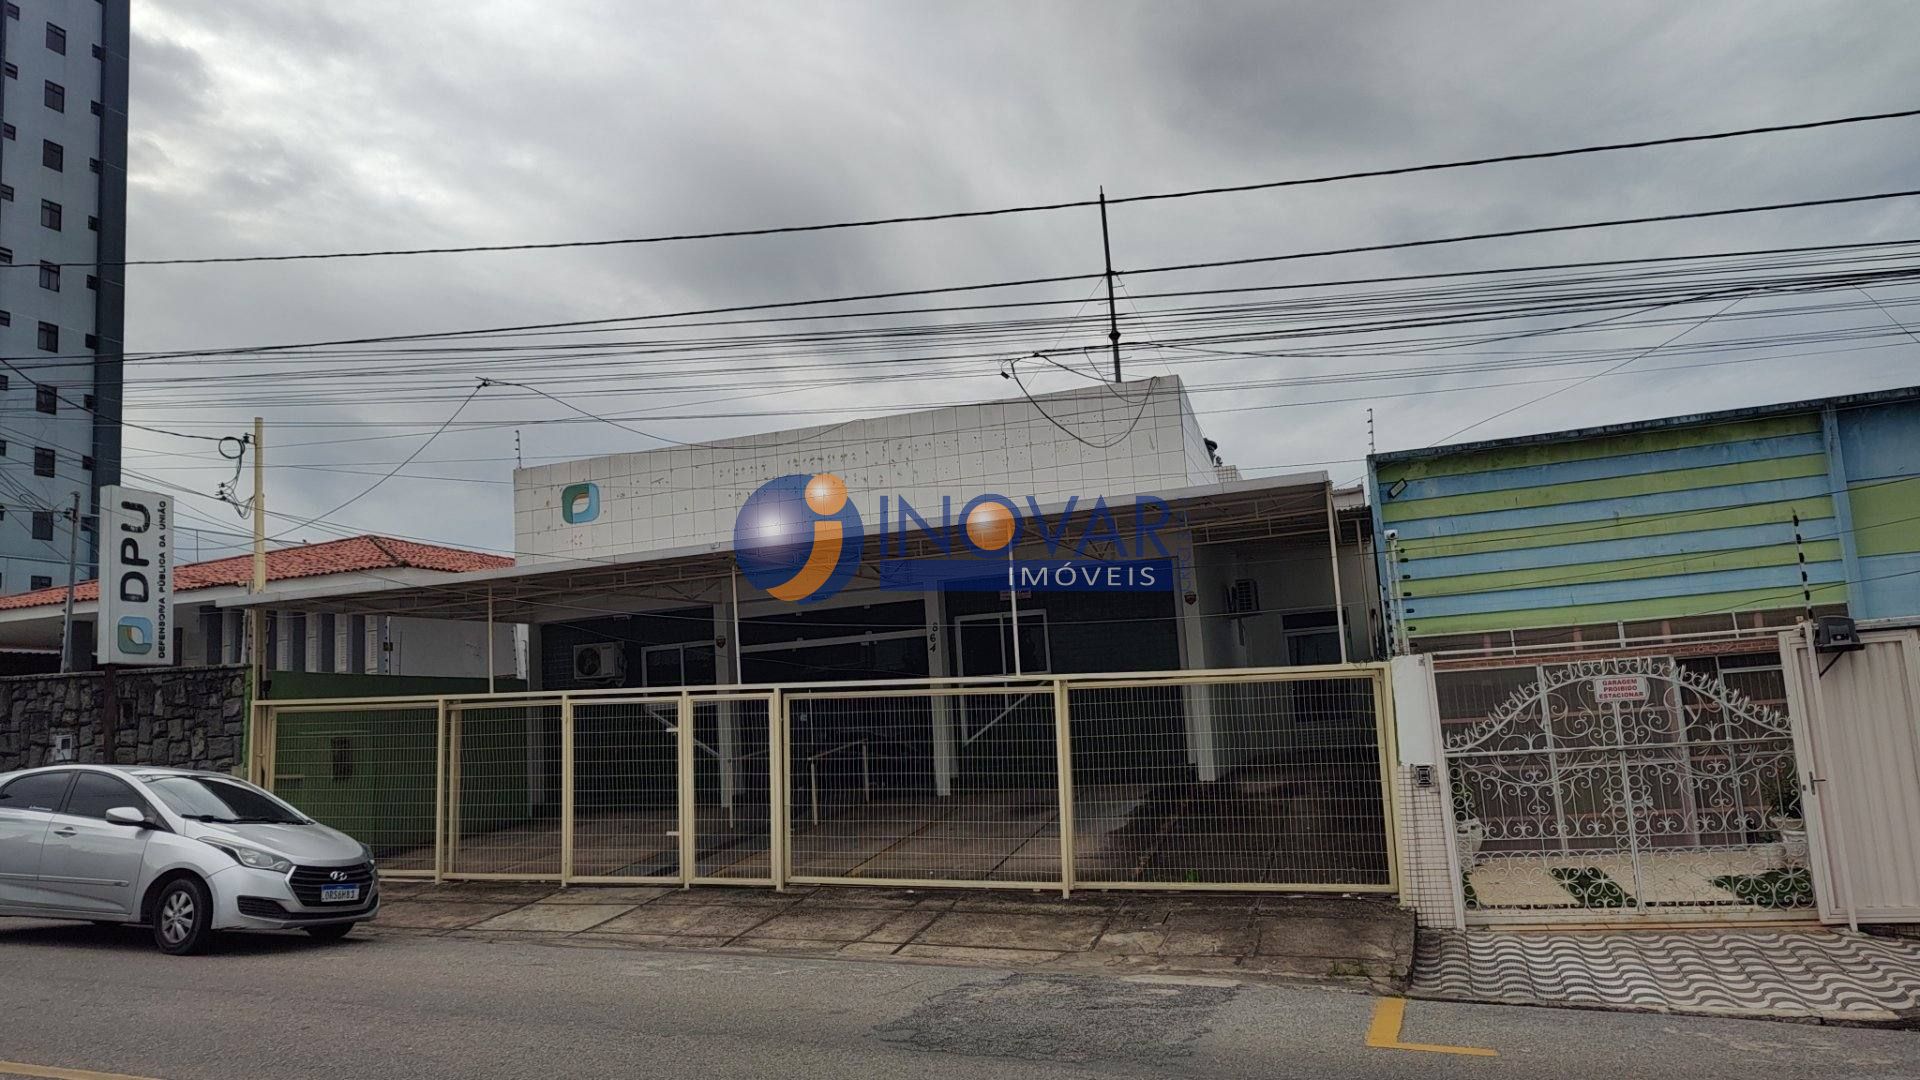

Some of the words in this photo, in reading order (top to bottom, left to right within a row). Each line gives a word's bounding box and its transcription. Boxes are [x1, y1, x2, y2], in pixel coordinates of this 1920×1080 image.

[157, 501, 167, 530] UNIÃO
[121, 501, 150, 602] DPU
[158, 536, 166, 548] DA
[157, 551, 166, 593] PÚBLICA
[157, 597, 166, 659] DEFENSORIA
